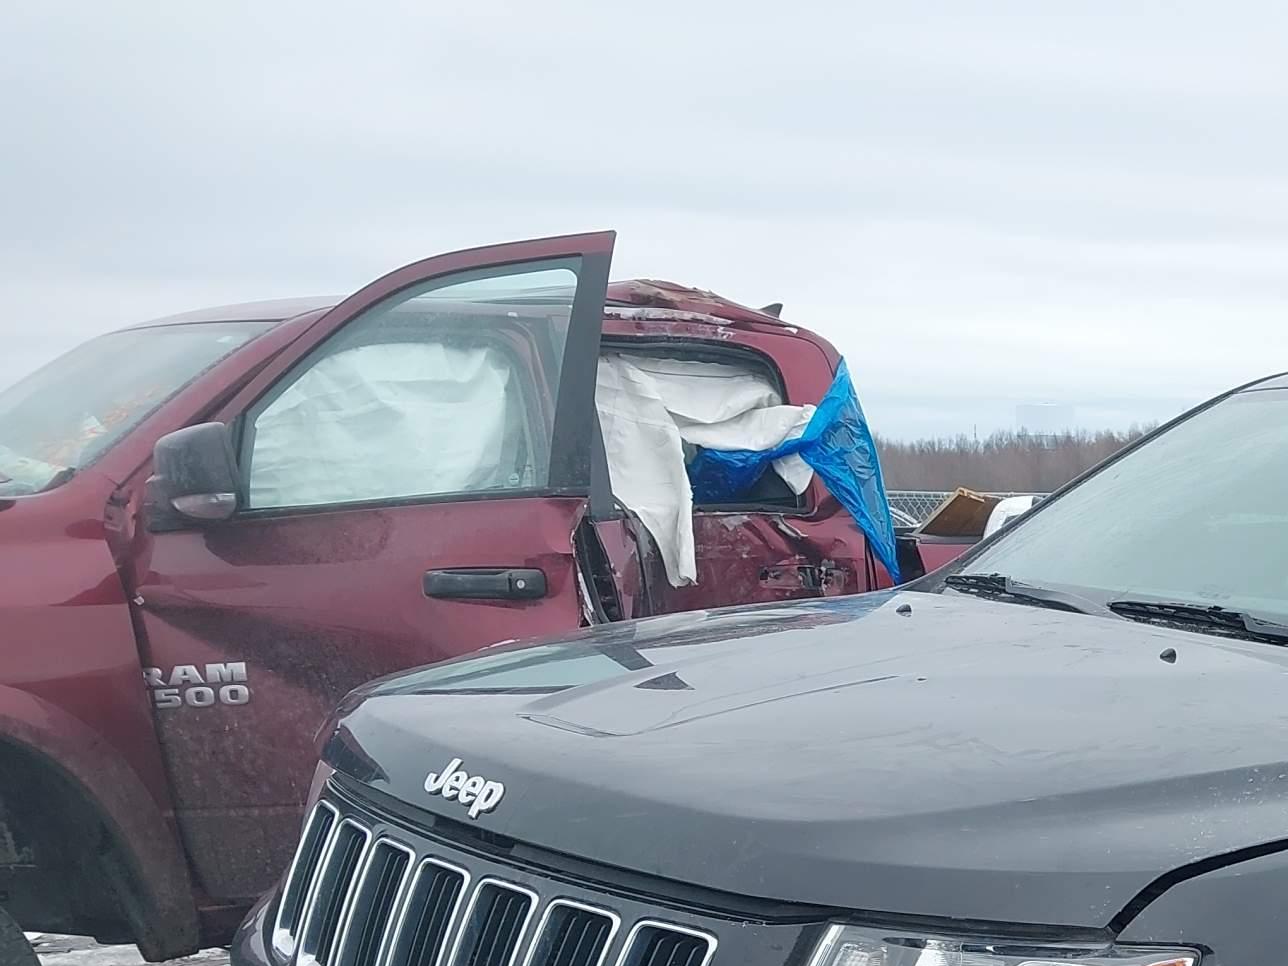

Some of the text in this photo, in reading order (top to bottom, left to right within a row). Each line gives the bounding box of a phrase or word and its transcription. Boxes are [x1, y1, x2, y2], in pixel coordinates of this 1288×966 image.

[142, 661, 248, 687] RAM
[146, 684, 250, 709] 500
[423, 757, 505, 820] Jeep
